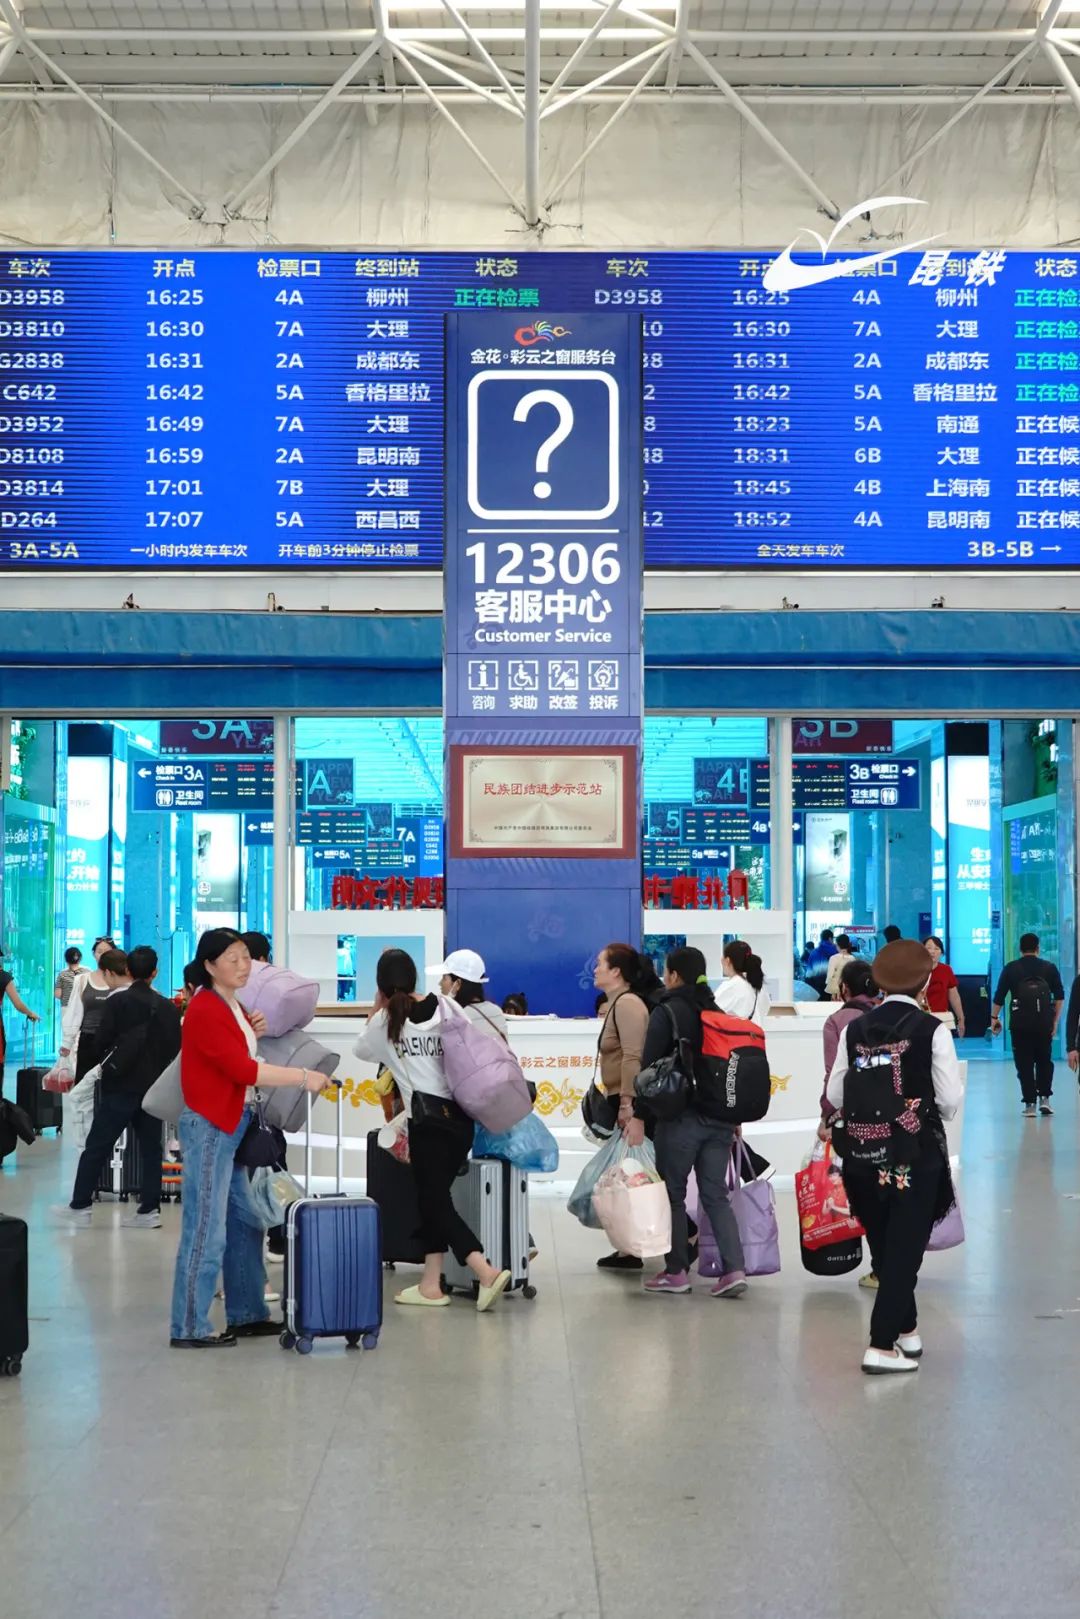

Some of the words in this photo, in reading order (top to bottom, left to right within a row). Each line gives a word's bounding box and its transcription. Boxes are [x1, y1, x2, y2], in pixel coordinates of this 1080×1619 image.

[9, 258, 50, 277] 车次
[152, 258, 195, 277] 开点
[257, 258, 320, 277] 检票口
[355, 258, 419, 277] 终到站
[474, 257, 518, 277] 状态
[607, 257, 649, 277] 车次
[1035, 258, 1078, 277] 状态
[146, 289, 204, 306] 16:25
[274, 289, 304, 306] 4A
[366, 287, 409, 307] 柳州
[454, 288, 540, 307] 正在检票
[594, 289, 663, 305] D3958
[852, 289, 881, 305] 4A
[935, 288, 978, 307] 柳州
[1014, 288, 1080, 308] 正在检
[146, 320, 204, 337] 16:30
[275, 320, 304, 337] 7A
[366, 319, 409, 338] 大理
[733, 321, 791, 337] 16:30
[853, 321, 882, 337] 7A
[936, 319, 979, 339] 大理
[1014, 320, 1080, 339] 正在检
[146, 352, 204, 369] 16:31
[275, 352, 304, 369] 2A
[356, 351, 420, 371] 成都东
[733, 353, 791, 369] 16:31
[853, 352, 882, 368] 2A
[925, 351, 990, 371] 成都东
[1014, 351, 1080, 371] 正在检
[2, 384, 57, 401] C642
[146, 384, 204, 401] 16:42
[276, 384, 304, 400] 5A
[345, 383, 431, 403] 香格里拉
[733, 384, 791, 401] 16:42
[854, 384, 882, 400] 5A
[912, 383, 998, 402] 香格里拉
[1015, 383, 1080, 403] 正在检
[146, 415, 204, 432] 16:49
[275, 416, 304, 432] 7A
[366, 414, 409, 434] 大理
[733, 416, 791, 432] 18:23
[854, 415, 883, 432] 5A
[936, 414, 980, 434] 南通
[146, 447, 204, 464] 16:59
[275, 447, 304, 464] 2A
[357, 446, 421, 466] 昆明南
[733, 448, 791, 464] 18:31
[854, 447, 882, 463] 6B
[937, 446, 980, 465] 大理
[145, 479, 203, 496] 17:01
[276, 479, 304, 495] 7B
[366, 478, 409, 497] 大理
[733, 480, 791, 496] 18:45
[853, 479, 882, 495] 4B
[925, 478, 991, 498] 上海南
[1, 511, 58, 528] D264
[145, 511, 204, 528] 17:07
[275, 511, 304, 527] 5A
[355, 510, 421, 529] 西昌西
[733, 512, 791, 527] 18:52
[853, 511, 883, 527] 4A
[927, 509, 991, 529] 昆明南
[10, 541, 79, 558] 3A-5A
[130, 543, 248, 558] 一小时内发车车次
[278, 543, 419, 558] 开车前3分钟停止检票
[757, 543, 845, 558] 全天发车车次
[967, 541, 1034, 558] 3B-5B
[465, 542, 621, 585] 12306
[474, 588, 613, 624] 客服中心
[474, 629, 551, 643] Customer
[554, 628, 612, 643] Service
[472, 695, 495, 710] 咨询
[508, 695, 538, 710] 求助
[548, 695, 578, 710] 改签
[589, 695, 619, 710] 投诉
[184, 765, 204, 781] 3A
[849, 764, 870, 780] 3B
[175, 790, 204, 800] 卫生间
[483, 783, 603, 796] 民族团结进步示范站
[850, 789, 879, 799] 卫生间
[396, 827, 416, 842] 7A
[752, 820, 768, 833] 4B
[726, 1051, 740, 1108] ARMOUR
